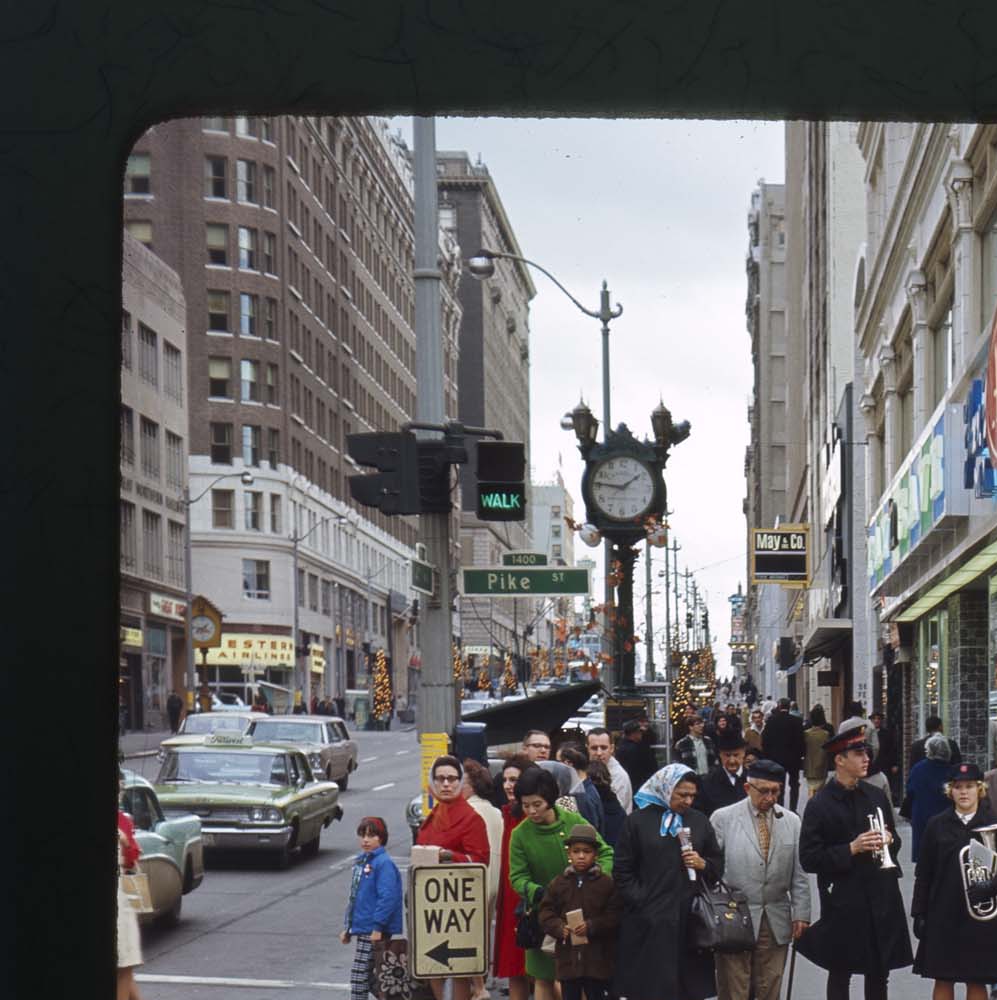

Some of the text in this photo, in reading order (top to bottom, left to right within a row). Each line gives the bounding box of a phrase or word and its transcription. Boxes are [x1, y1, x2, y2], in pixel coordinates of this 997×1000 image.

[480, 493, 520, 508] WALK
[757, 533, 780, 551] May
[790, 533, 805, 549] Co.
[511, 555, 536, 564] 1400
[487, 573, 564, 590] Pike ST
[424, 877, 476, 903] ONE
[424, 908, 476, 934] WAY
